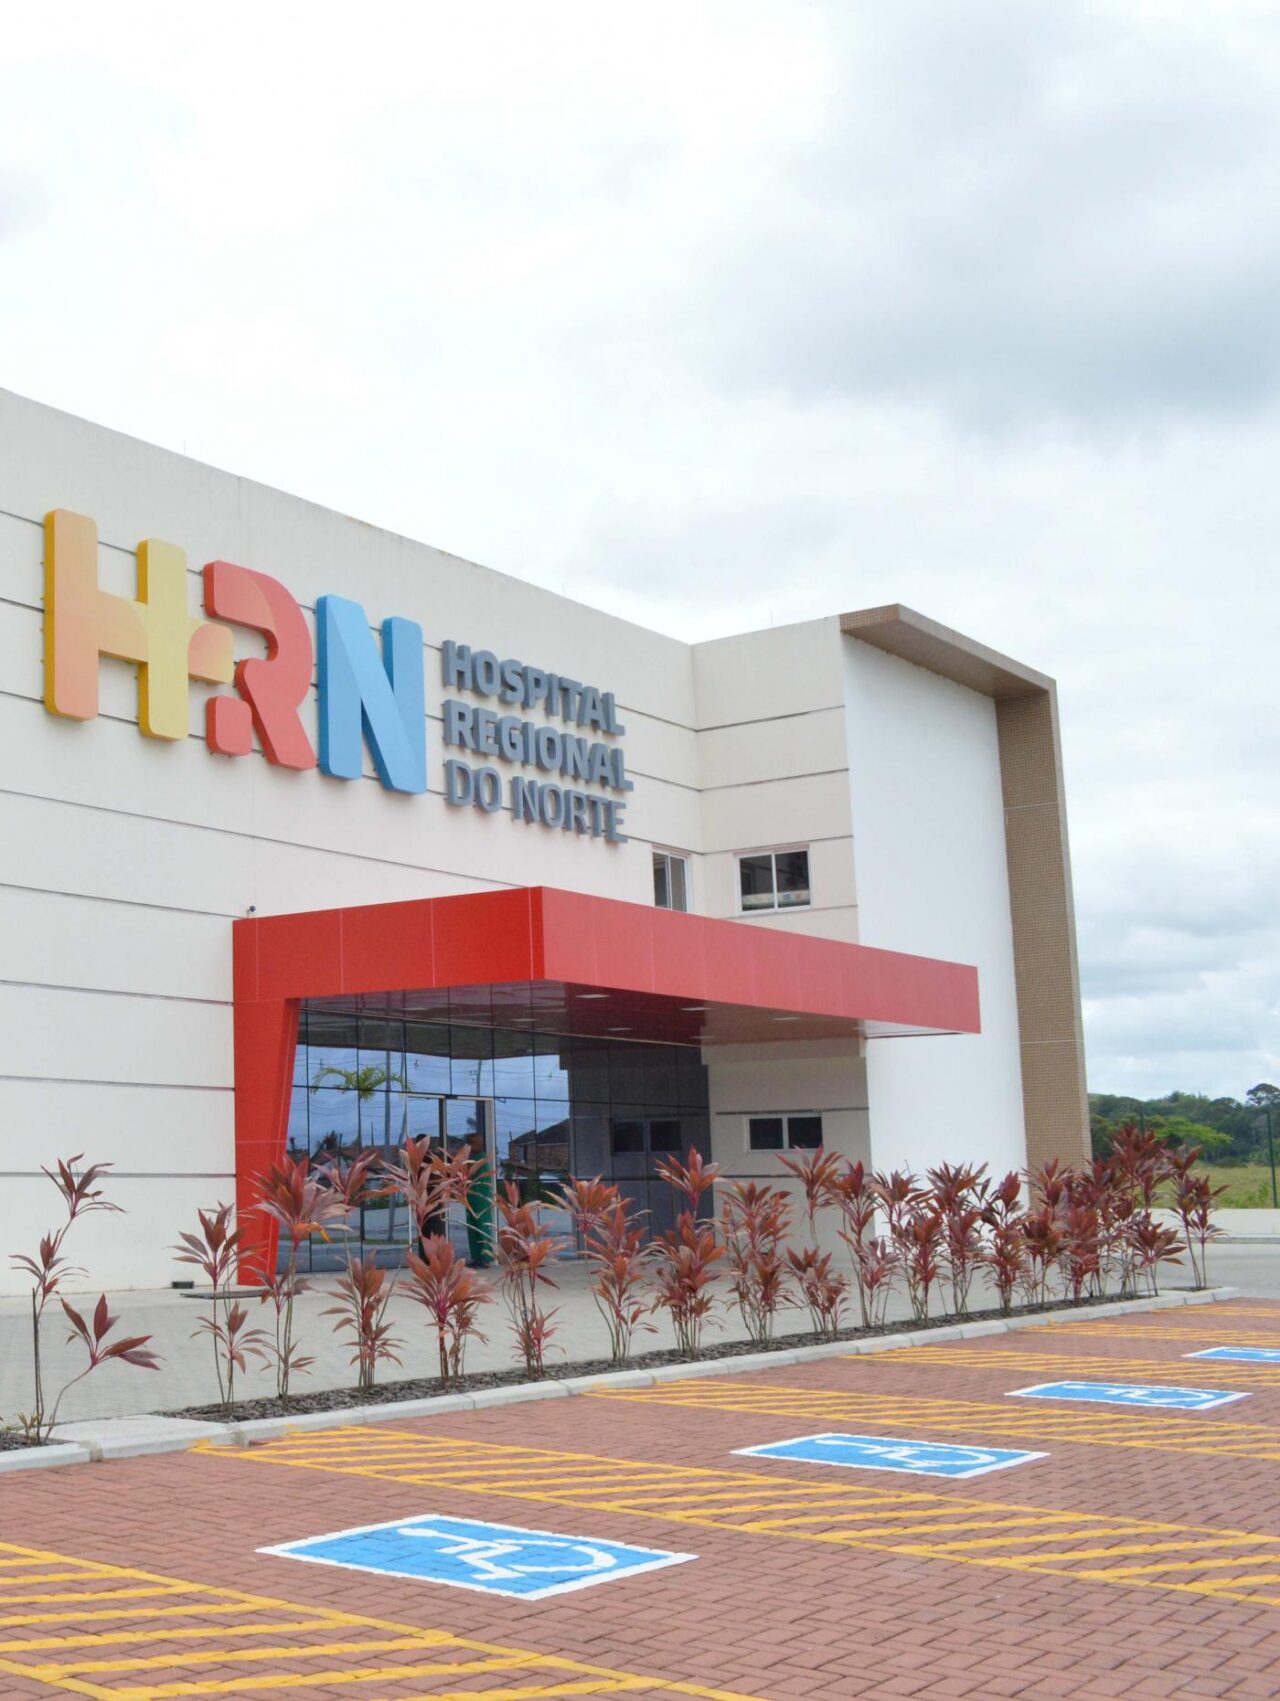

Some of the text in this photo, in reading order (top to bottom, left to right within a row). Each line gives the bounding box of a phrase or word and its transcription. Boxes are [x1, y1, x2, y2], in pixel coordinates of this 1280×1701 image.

[43, 508, 427, 796] HRN
[442, 640, 626, 736] HOSPITAL
[443, 699, 634, 791] REGIONAL
[445, 759, 628, 843] DO NORTE
